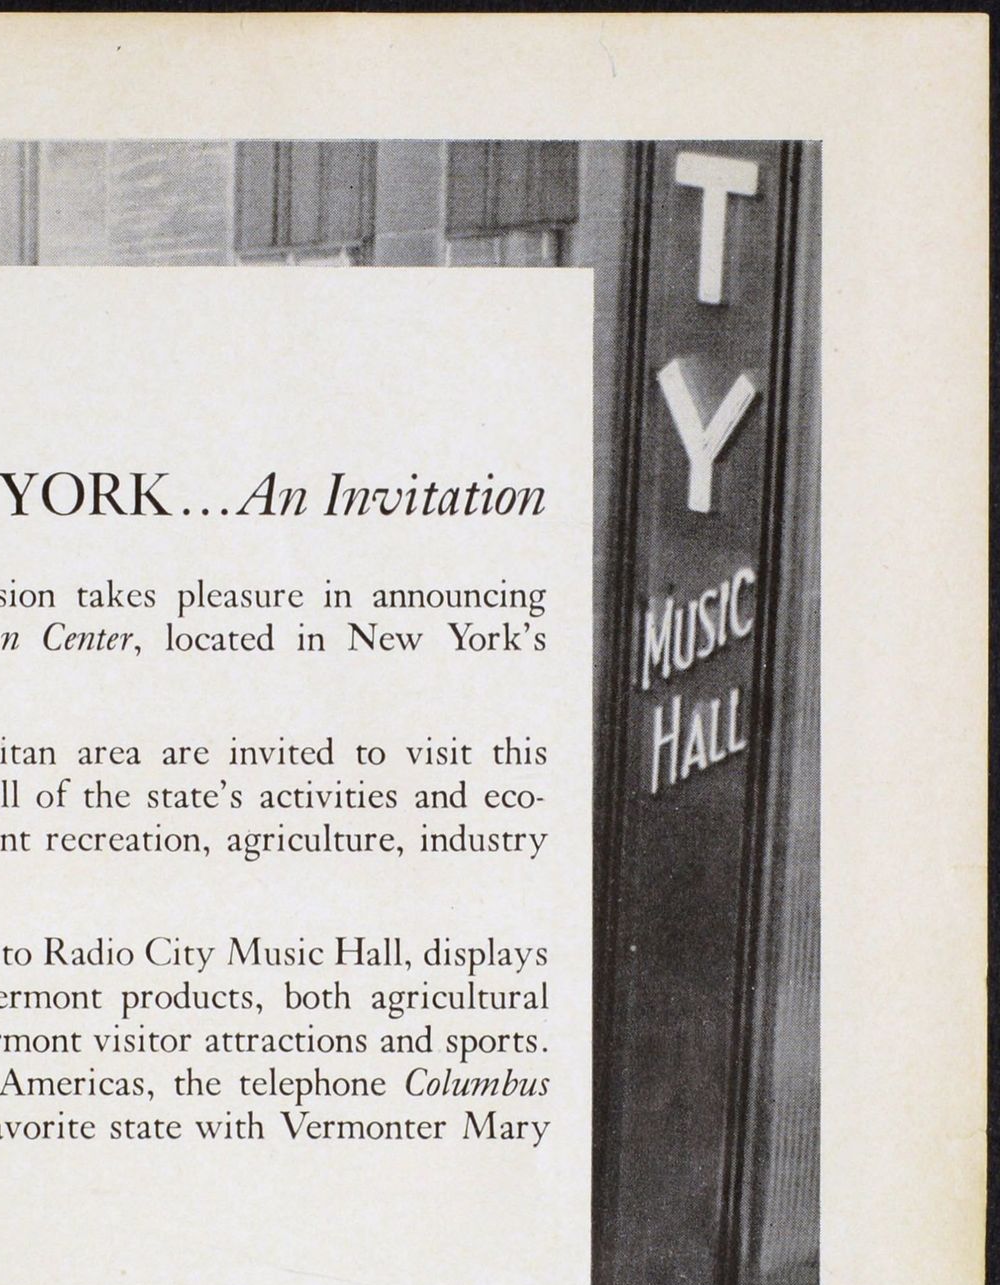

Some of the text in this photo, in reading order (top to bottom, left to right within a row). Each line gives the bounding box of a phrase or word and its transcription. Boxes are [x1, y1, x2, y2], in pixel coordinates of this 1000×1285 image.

[323, 472, 545, 516] Invitation
[77, 579, 156, 608] takes
[178, 579, 304, 618] pleasure
[324, 579, 352, 608] in
[372, 579, 547, 618] announcing
[42, 622, 141, 656] Center,
[166, 622, 274, 652] located
[297, 622, 325, 652] in
[347, 622, 423, 651] New
[447, 622, 546, 652] York's
[642, 567, 756, 691] MUSIC
[78, 746, 141, 765] area
[162, 746, 209, 766] are
[229, 736, 334, 766] invited
[356, 745, 386, 766] to
[406, 736, 472, 765] visit
[493, 736, 547, 765] this
[651, 687, 747, 794] HALL
[36, 778, 71, 809] of
[83, 779, 130, 809] the
[147, 779, 242, 809] state's
[260, 780, 397, 809] activities
[415, 780, 467, 809] and
[484, 790, 544, 809] eco-
[46, 823, 210, 857] recreation,
[227, 823, 404, 862] agriculture,
[420, 823, 548, 860] industry
[2, 945, 32, 966] to
[45, 937, 134, 966] Radio
[145, 937, 215, 974] City
[228, 937, 324, 966] Music
[335, 936, 412, 970] Hall,
[423, 937, 548, 977] displays
[121, 980, 263, 1020] products,
[284, 980, 351, 1010] both
[371, 981, 549, 1020] agricultural
[94, 1024, 192, 1053] visitor
[205, 1024, 367, 1053] attractions
[380, 1024, 433, 1053] and
[446, 1032, 548, 1064] sports.
[174, 1067, 221, 1096] the
[239, 1067, 386, 1107] telephone
[405, 1067, 550, 1097] Columbus
[110, 1119, 182, 1140] state
[195, 1110, 264, 1140] with
[280, 1111, 447, 1140] Vermonter
[463, 1110, 551, 1148] Mary
